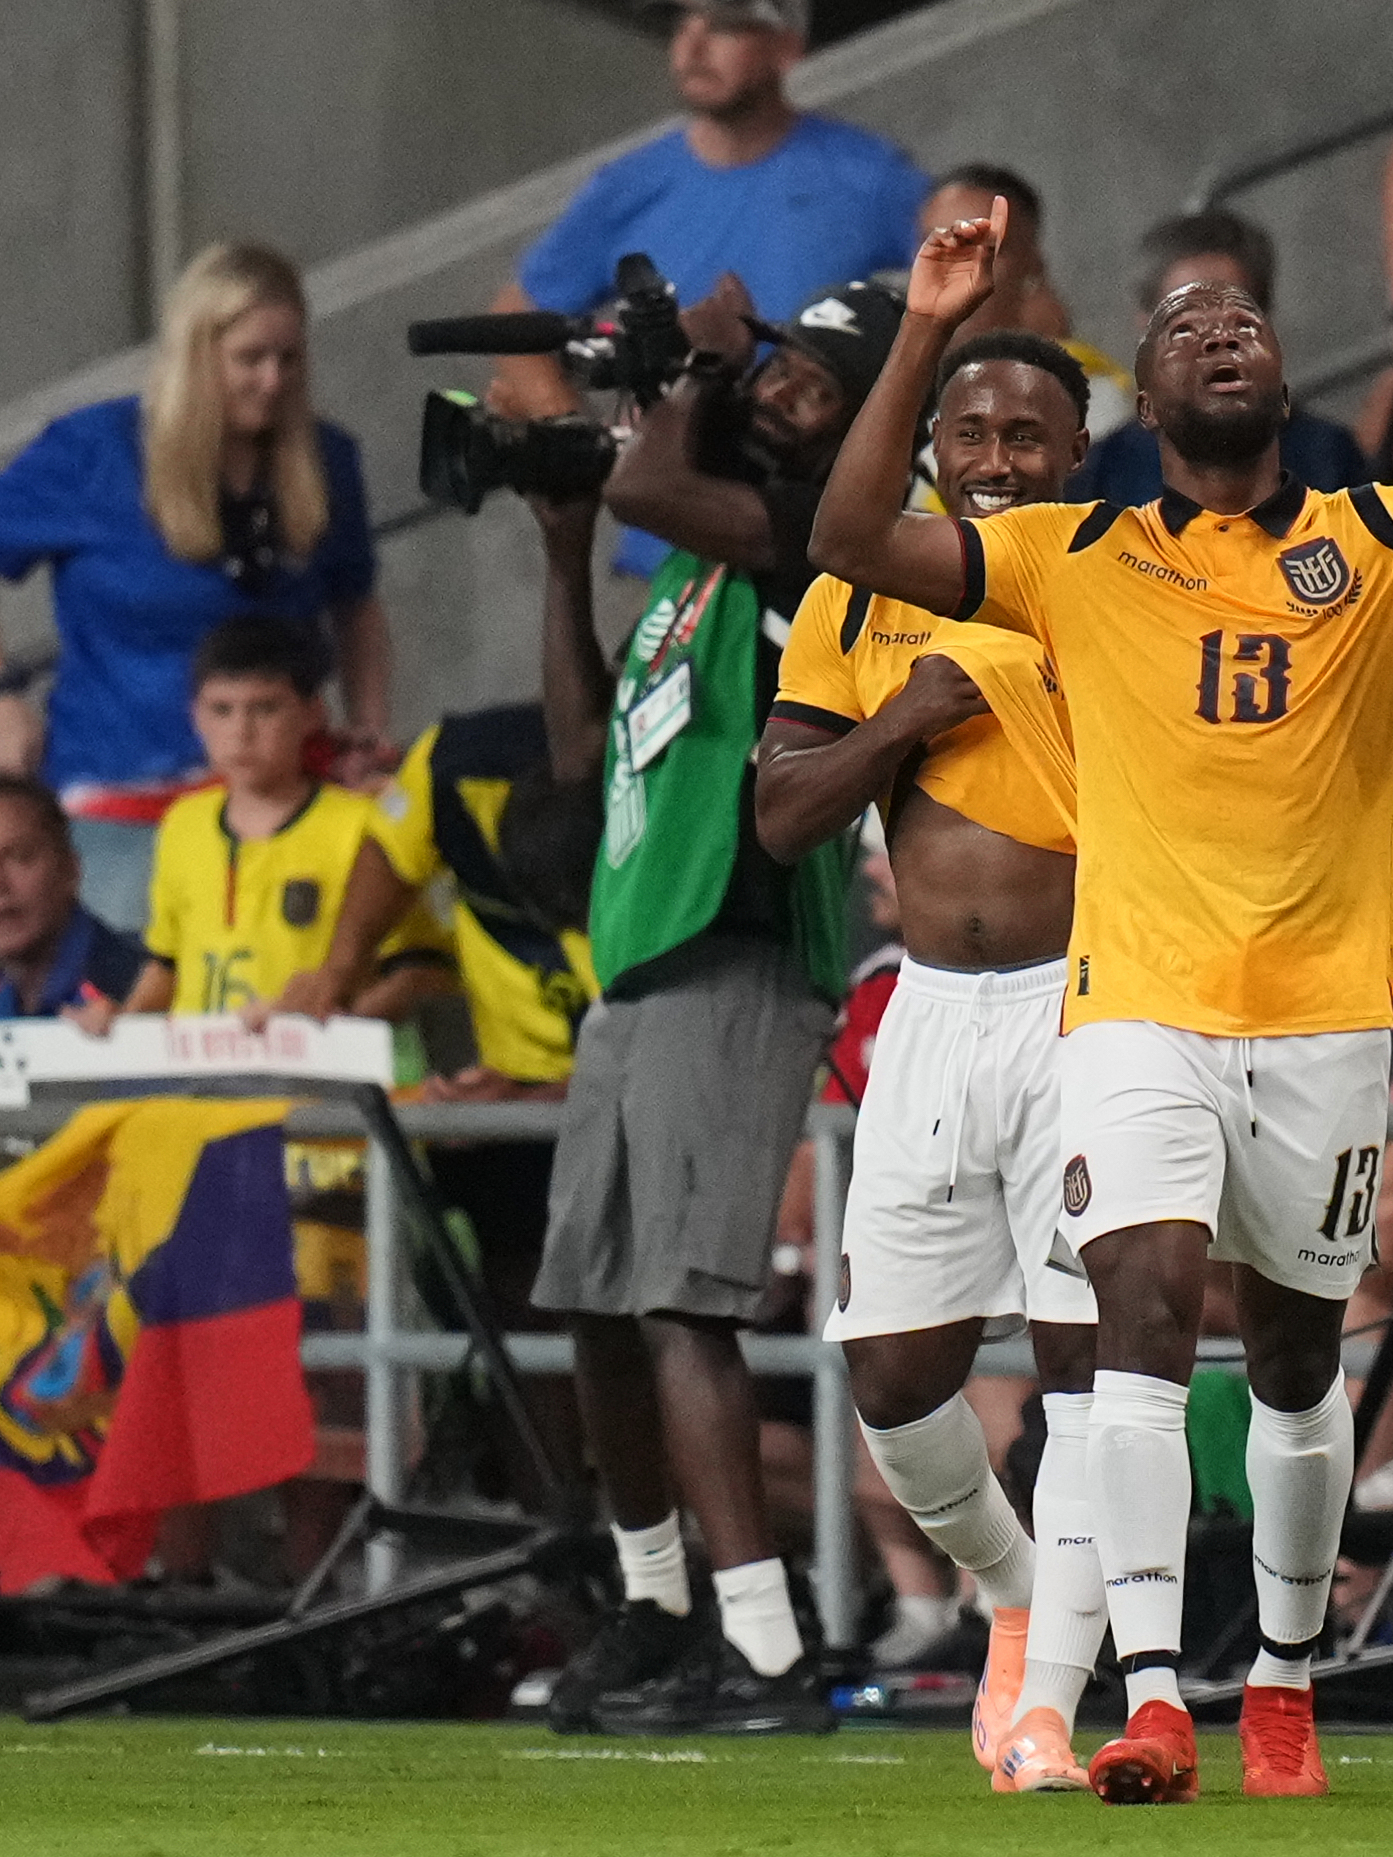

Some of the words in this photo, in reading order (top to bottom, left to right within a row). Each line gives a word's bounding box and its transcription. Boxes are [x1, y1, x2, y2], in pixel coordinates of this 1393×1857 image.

[1118, 551, 1207, 591] marathon
[1321, 603, 1343, 620] 100
[1194, 629, 1292, 725] 13
[1317, 1145, 1379, 1242] 13
[1058, 1536, 1095, 1546] mar
[1106, 1571, 1177, 1589] marathon
